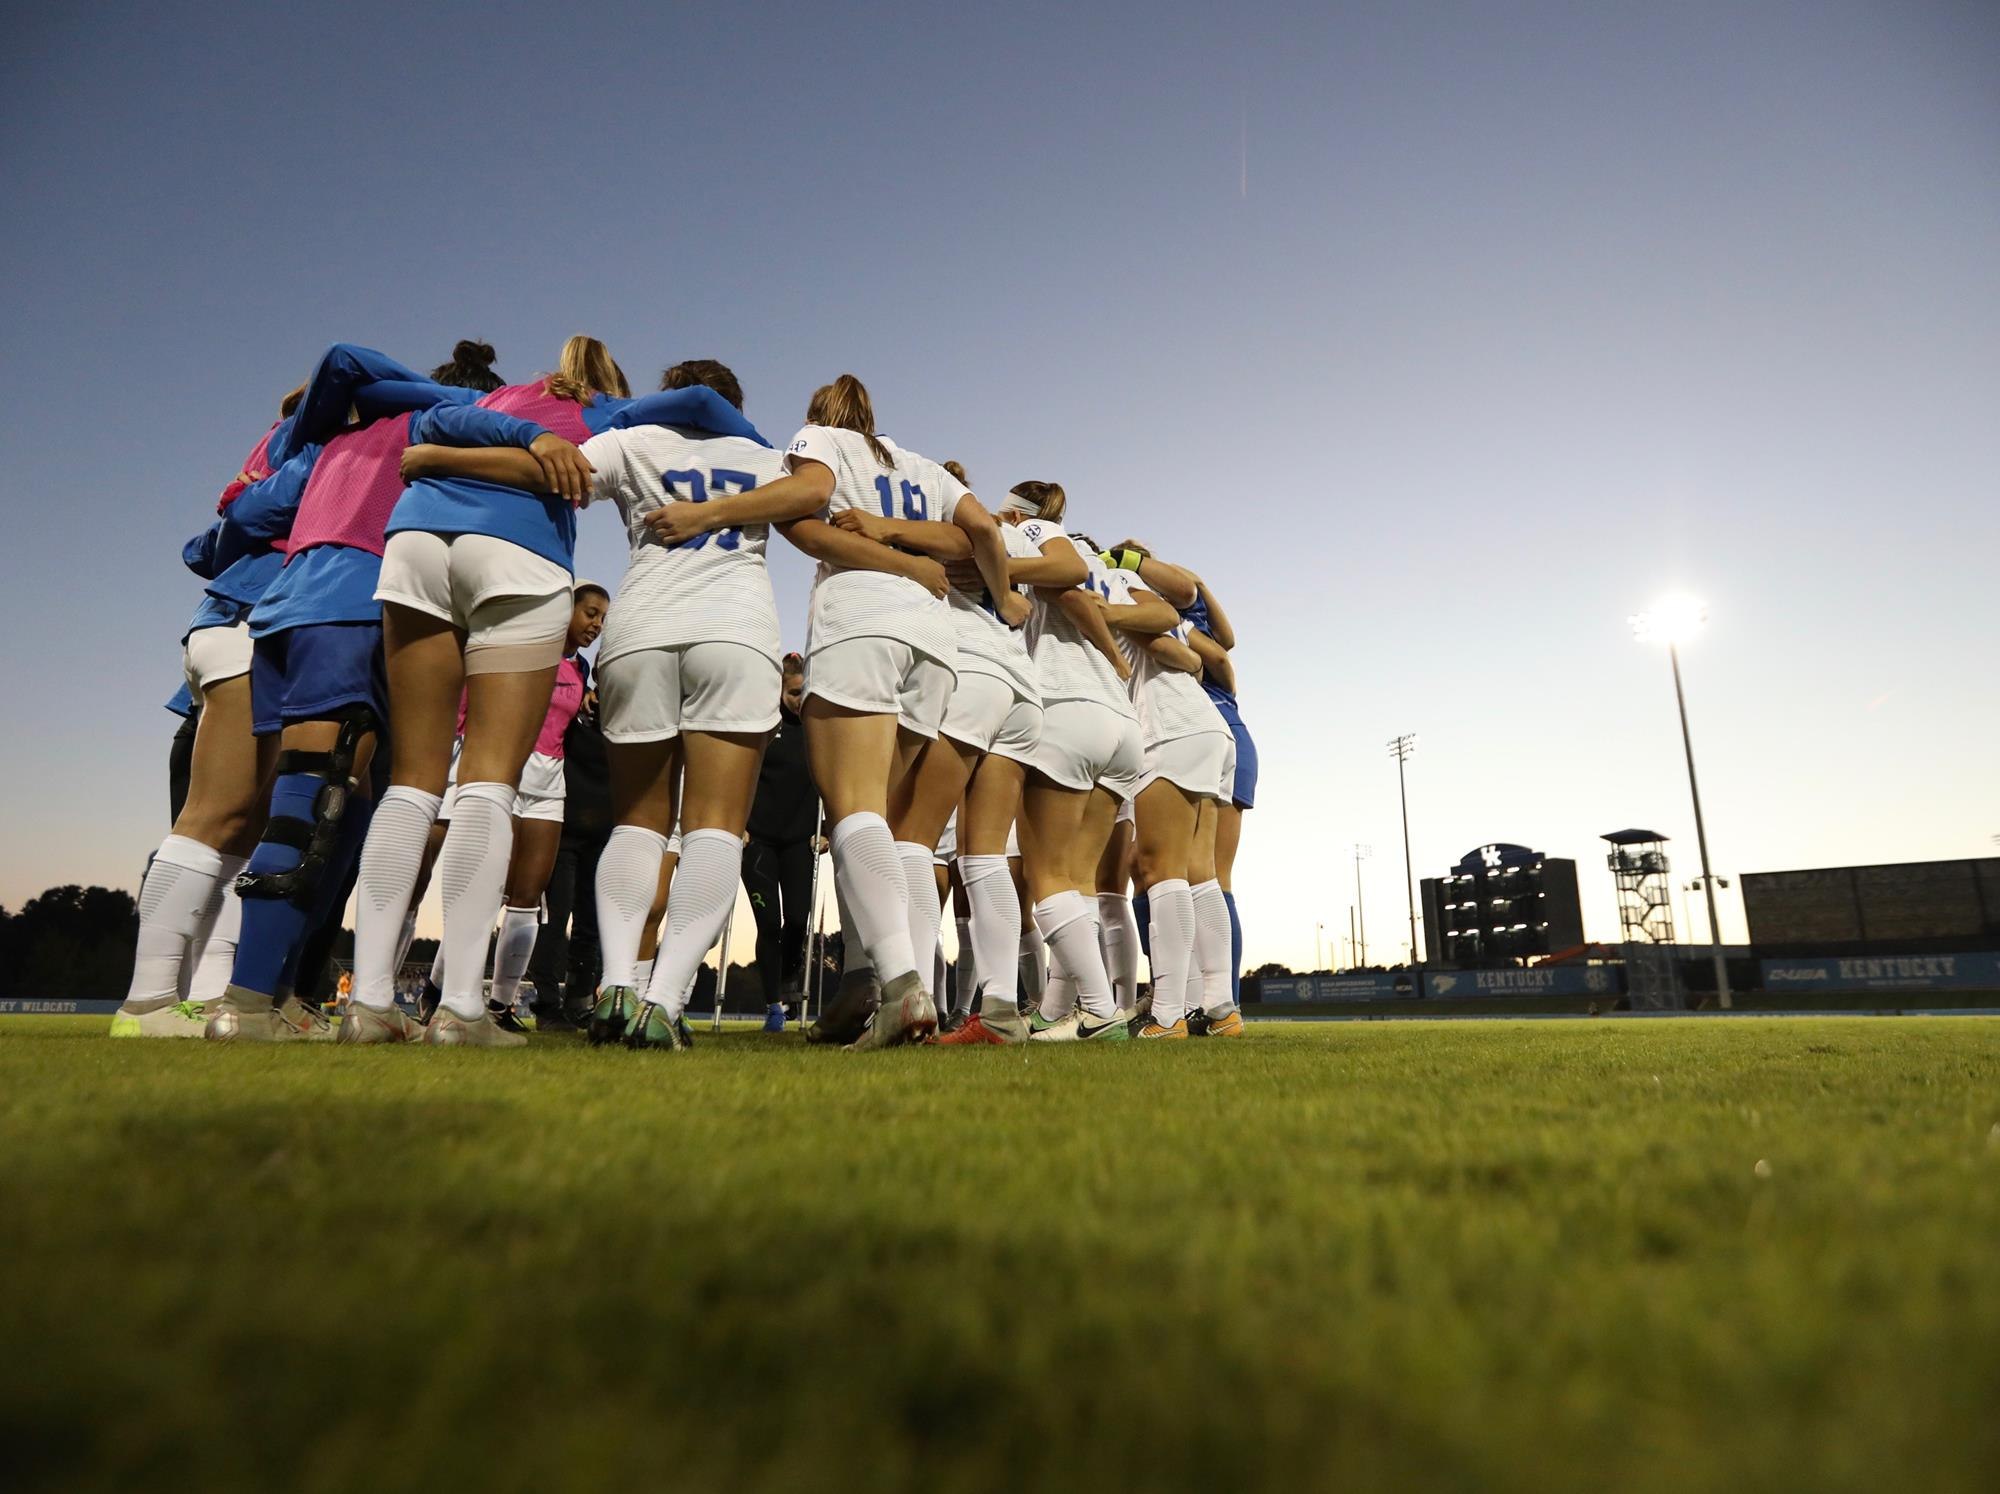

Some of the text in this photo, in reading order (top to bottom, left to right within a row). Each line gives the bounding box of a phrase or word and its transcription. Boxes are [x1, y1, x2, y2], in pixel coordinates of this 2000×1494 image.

[1839, 957, 1955, 978] KENTUCKY
[1476, 970, 1555, 988] KENTUCKY
[22, 1001, 77, 1012] WILDCATS
